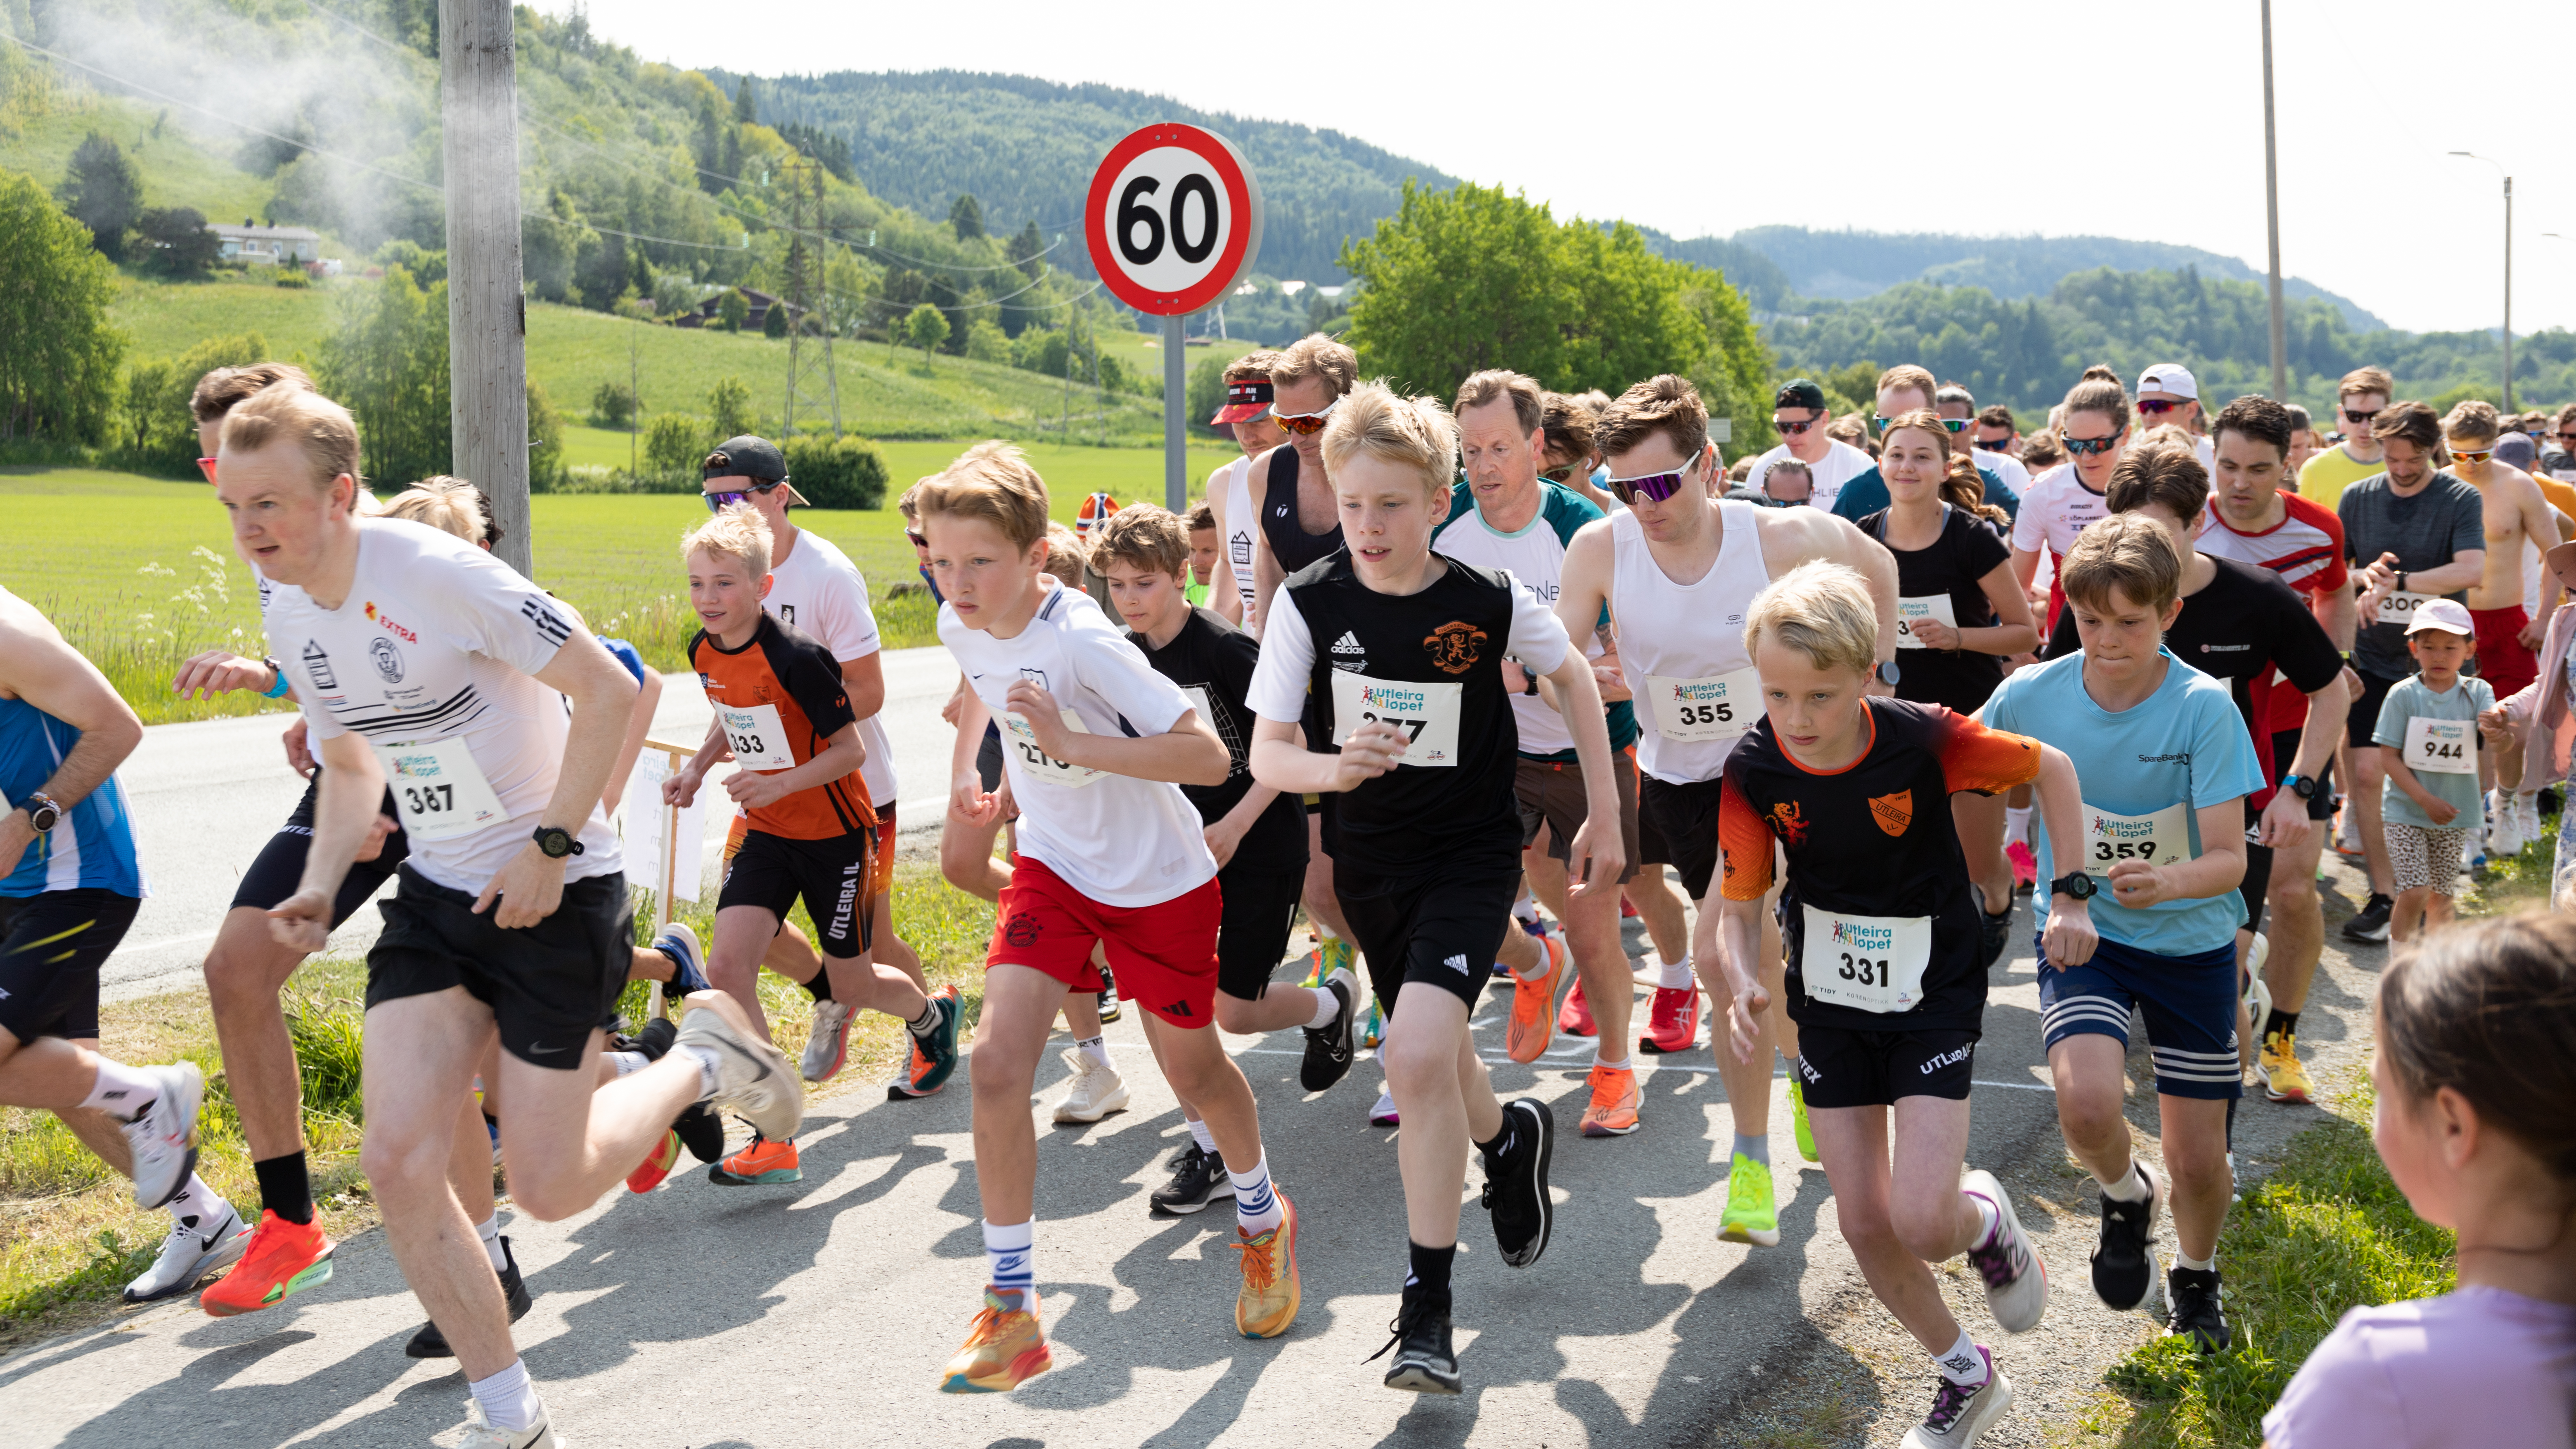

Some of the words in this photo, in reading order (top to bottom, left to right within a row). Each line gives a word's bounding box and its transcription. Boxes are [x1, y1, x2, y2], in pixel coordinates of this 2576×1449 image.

[1117, 173, 1219, 265] 60
[1814, 488, 1840, 497] HLIE
[380, 615, 417, 644] EXTRA
[1438, 623, 1474, 633] TIGERSKOLEN
[1331, 645, 1365, 654] adidas
[1376, 688, 1424, 701] Utleira
[1685, 682, 1726, 693] Utleira
[1695, 689, 1726, 700] løpet
[1385, 699, 1423, 711] løpet
[1680, 703, 1733, 725] 355
[731, 733, 764, 753] 333
[2425, 742, 2463, 759] 944
[2138, 753, 2183, 763] SpareBank
[405, 783, 453, 814] 387
[1876, 803, 1906, 823] UTLEIRA
[2107, 819, 2153, 830] Utleira
[2117, 827, 2153, 838] løpet
[2095, 841, 2157, 860] 359
[828, 878, 857, 940] UTLEIRA
[843, 862, 859, 874] IL
[1845, 923, 1892, 938] Utleira
[1854, 935, 1892, 951] løpet
[1444, 959, 1469, 976] adidas
[1839, 952, 1888, 987] 331
[1847, 992, 1889, 1004] KORENOPTIKK
